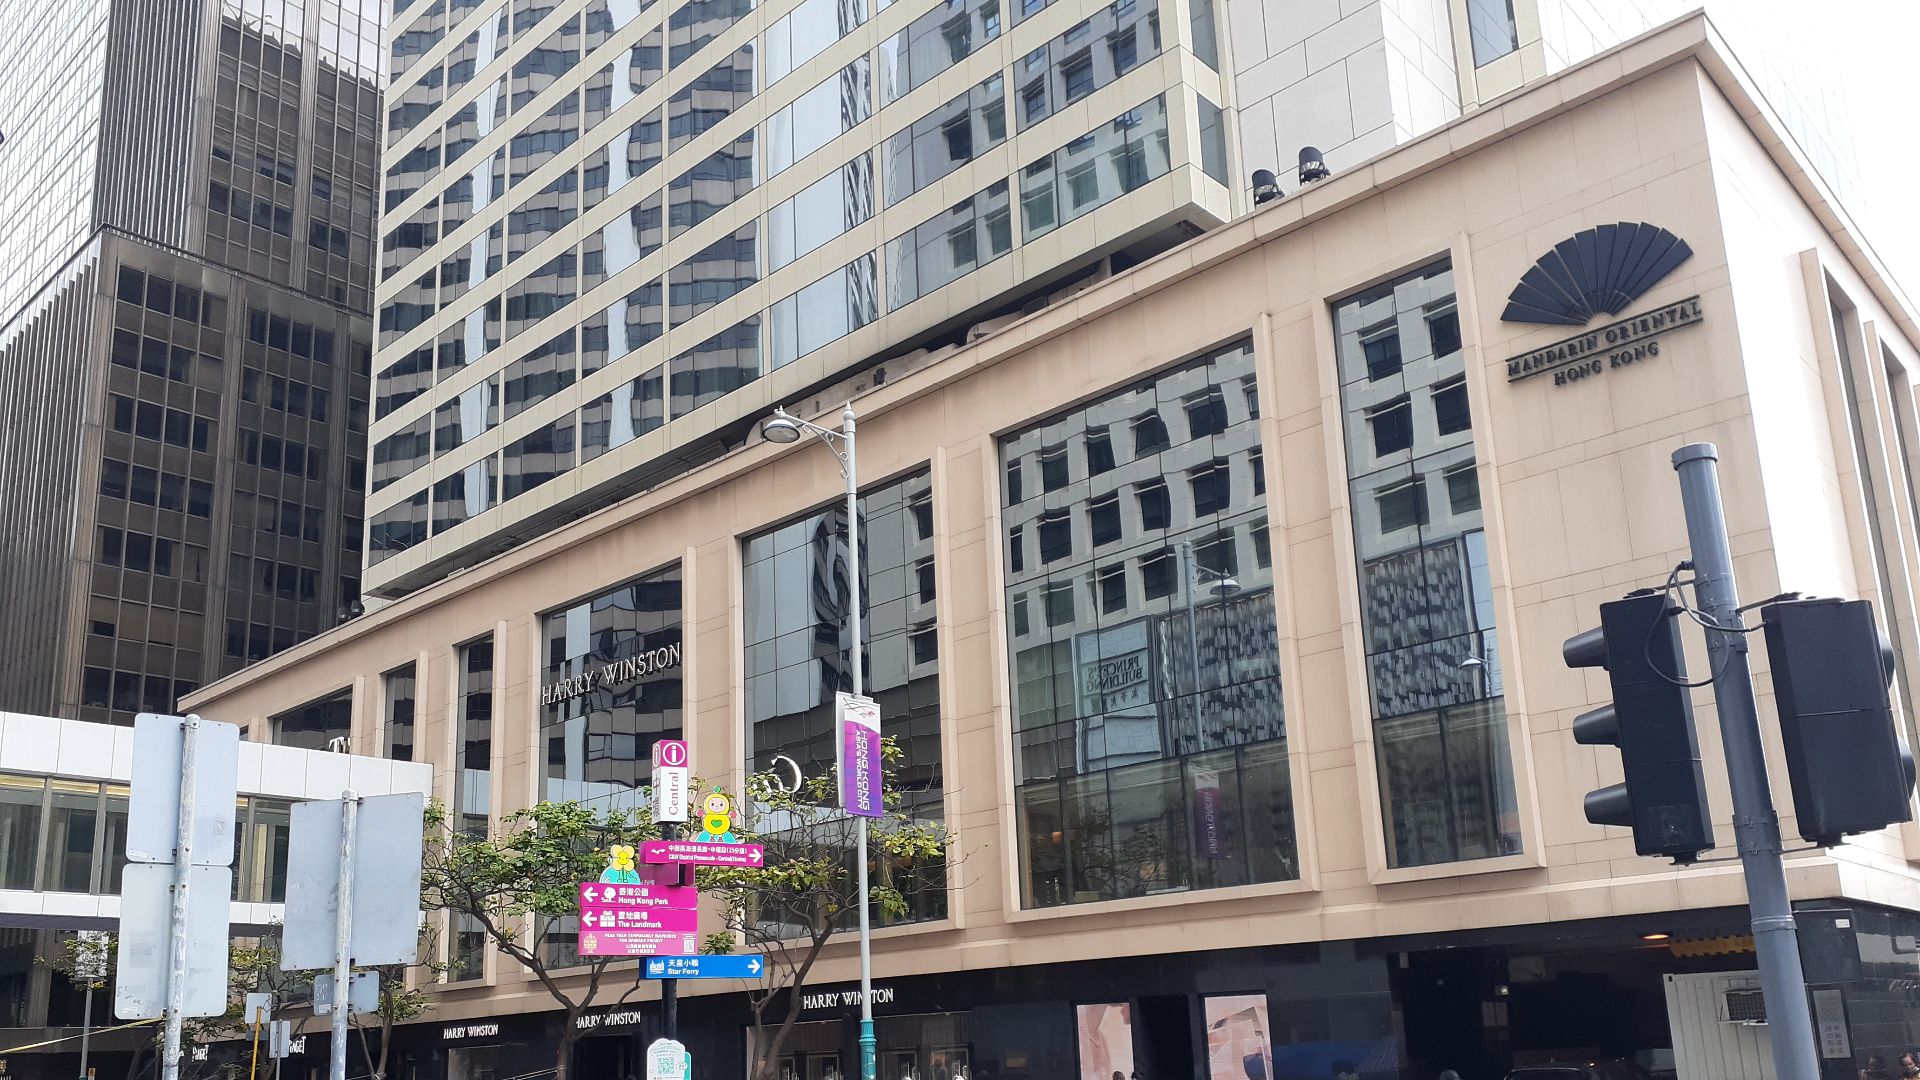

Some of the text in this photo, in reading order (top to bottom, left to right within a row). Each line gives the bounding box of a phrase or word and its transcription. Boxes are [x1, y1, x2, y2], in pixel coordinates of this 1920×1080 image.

[1507, 300, 1703, 376] MANDARIN ORIENTAL
[1554, 341, 1659, 386] HONG KONG
[541, 642, 681, 706] HARRY WINSTON
[860, 730, 870, 811] HONG KONG
[668, 772, 679, 816] Central
[618, 897, 635, 905] Hong
[637, 897, 653, 905] Kong
[668, 958, 699, 968] 天星小輪
[682, 968, 700, 976] Ferry
[803, 988, 894, 1010] HARRY WINTON
[443, 1024, 499, 1040] HARRY WINSTON
